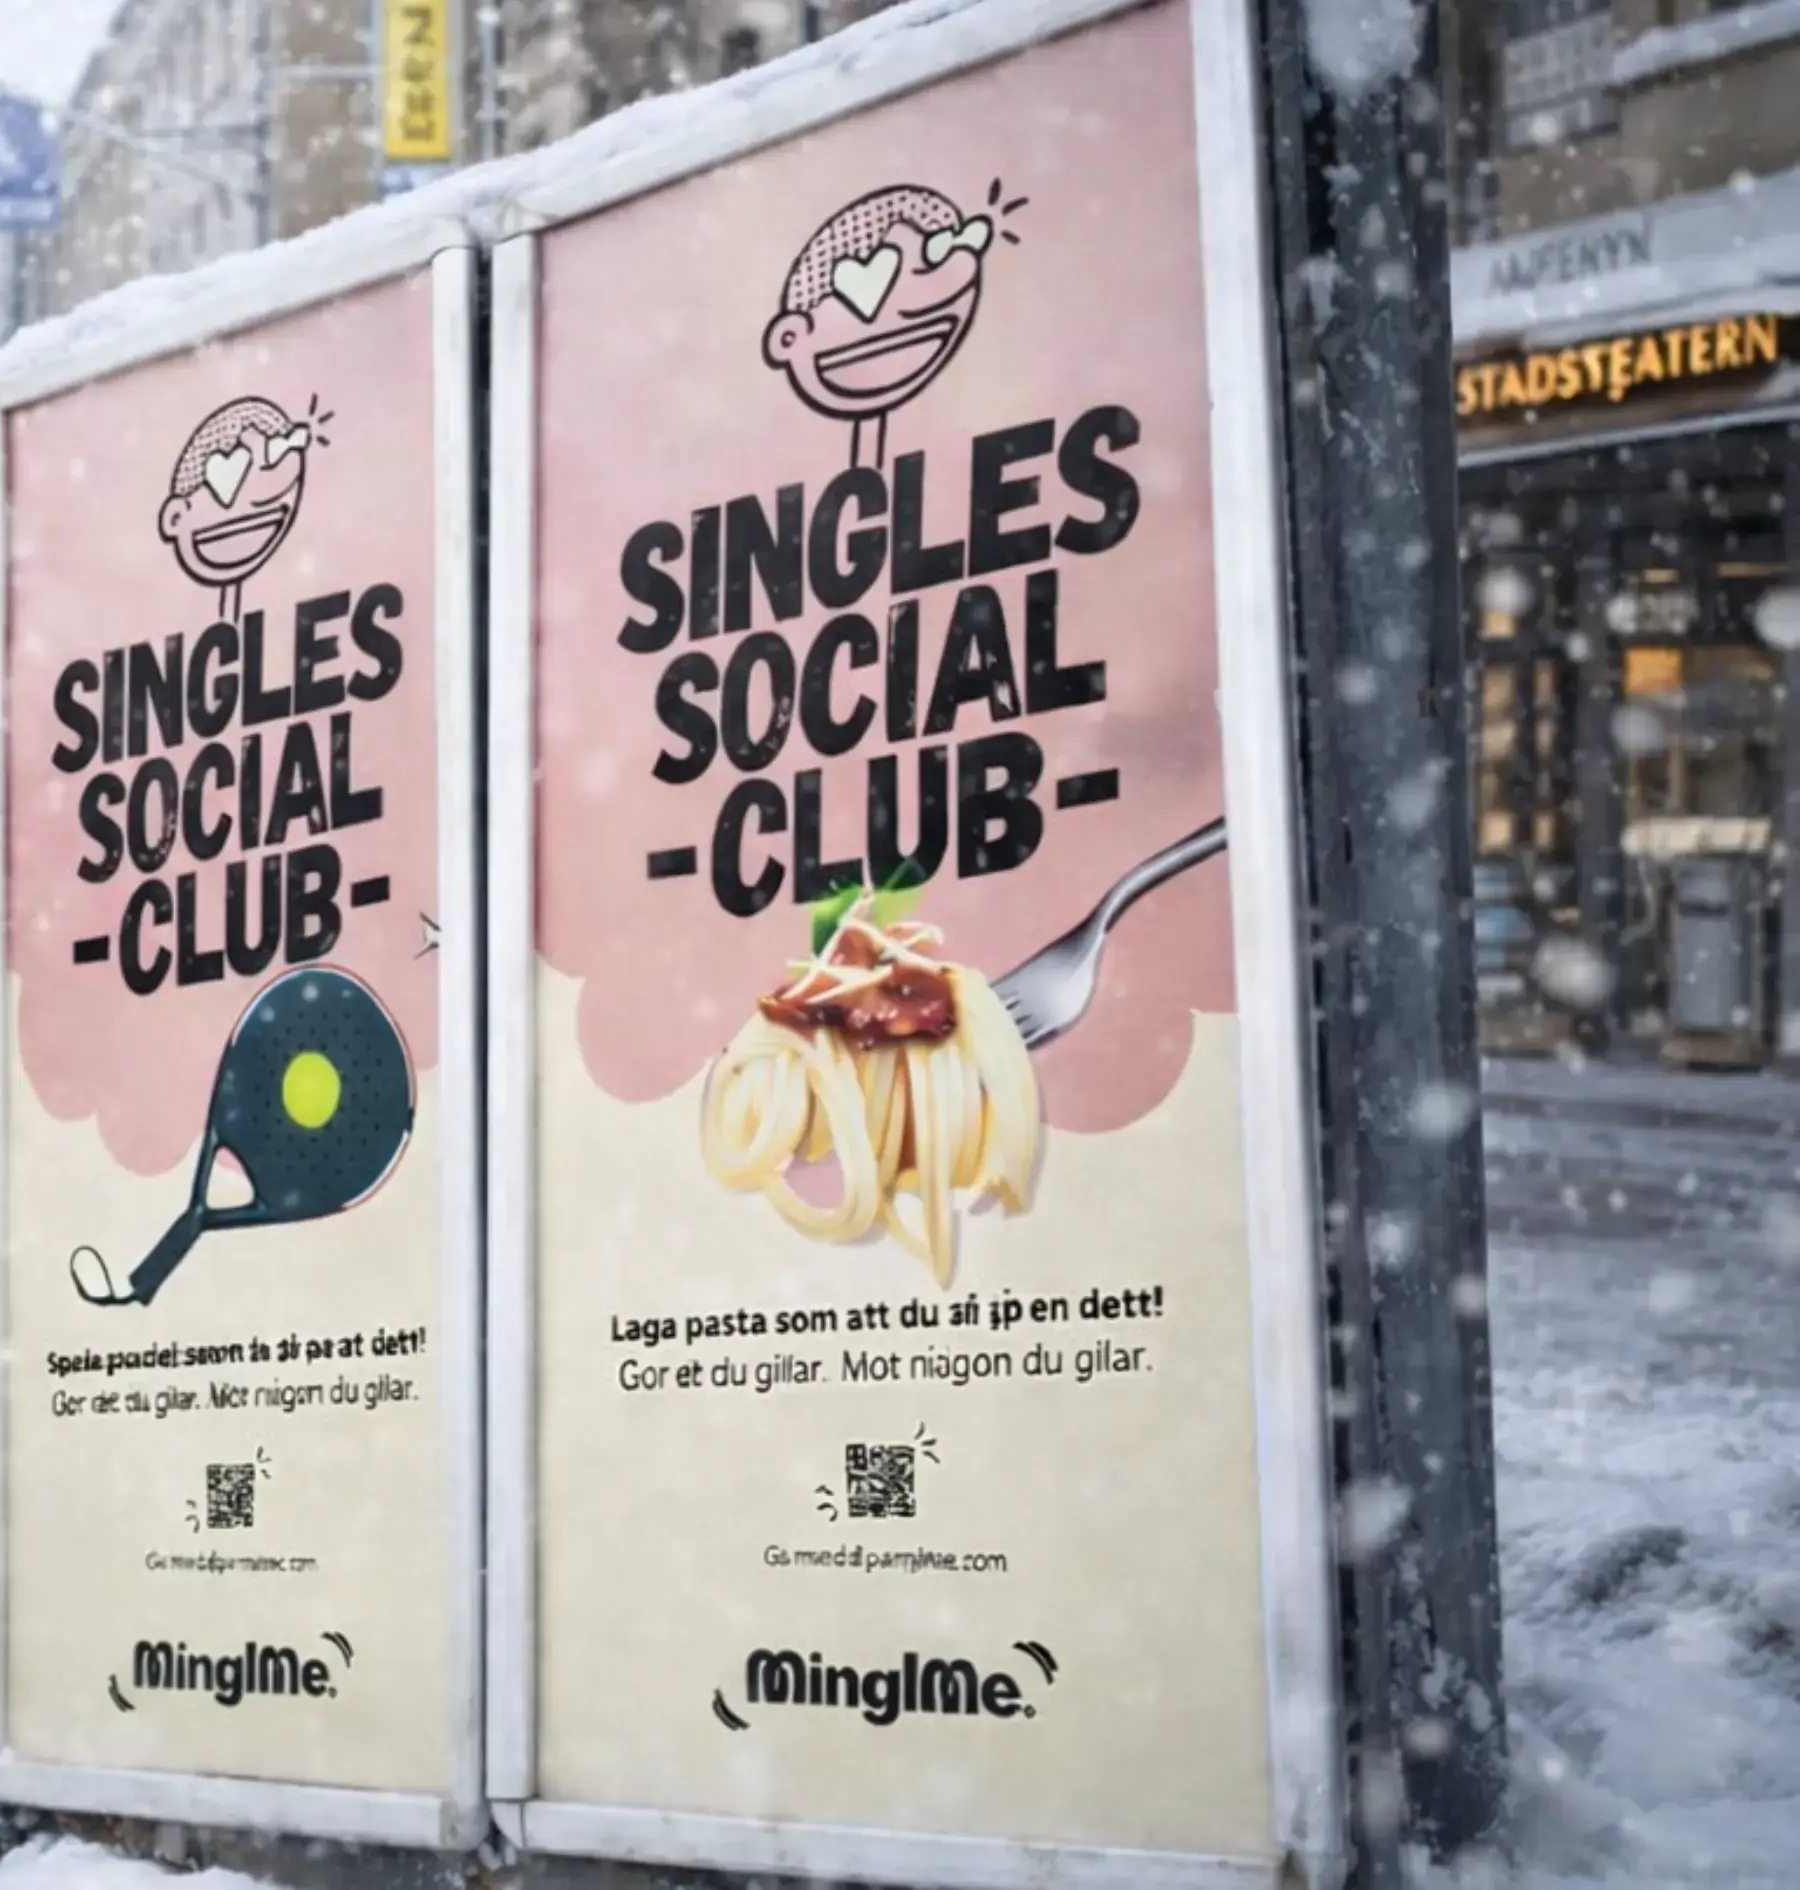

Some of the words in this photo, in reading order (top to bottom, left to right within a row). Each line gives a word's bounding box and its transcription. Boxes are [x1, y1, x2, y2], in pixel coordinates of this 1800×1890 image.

[617, 404, 1141, 653] SINGLES
[51, 582, 404, 773] SINGLES
[651, 567, 1107, 785] SOCIAL
[77, 711, 383, 884] SOCIAL
[646, 731, 1120, 918] -CLUB-
[73, 843, 391, 996] -CLUB-
[330, 1374, 359, 1404] du
[611, 1314, 677, 1347] Laga
[686, 1308, 767, 1346] pasta
[774, 1308, 838, 1335] som
[846, 1302, 891, 1331] att
[900, 1298, 939, 1328] du
[1030, 1297, 1069, 1322] en
[1079, 1285, 1164, 1319] dett!
[711, 1356, 747, 1387] du
[842, 1349, 901, 1382] Mot
[1023, 1342, 1063, 1376] du
